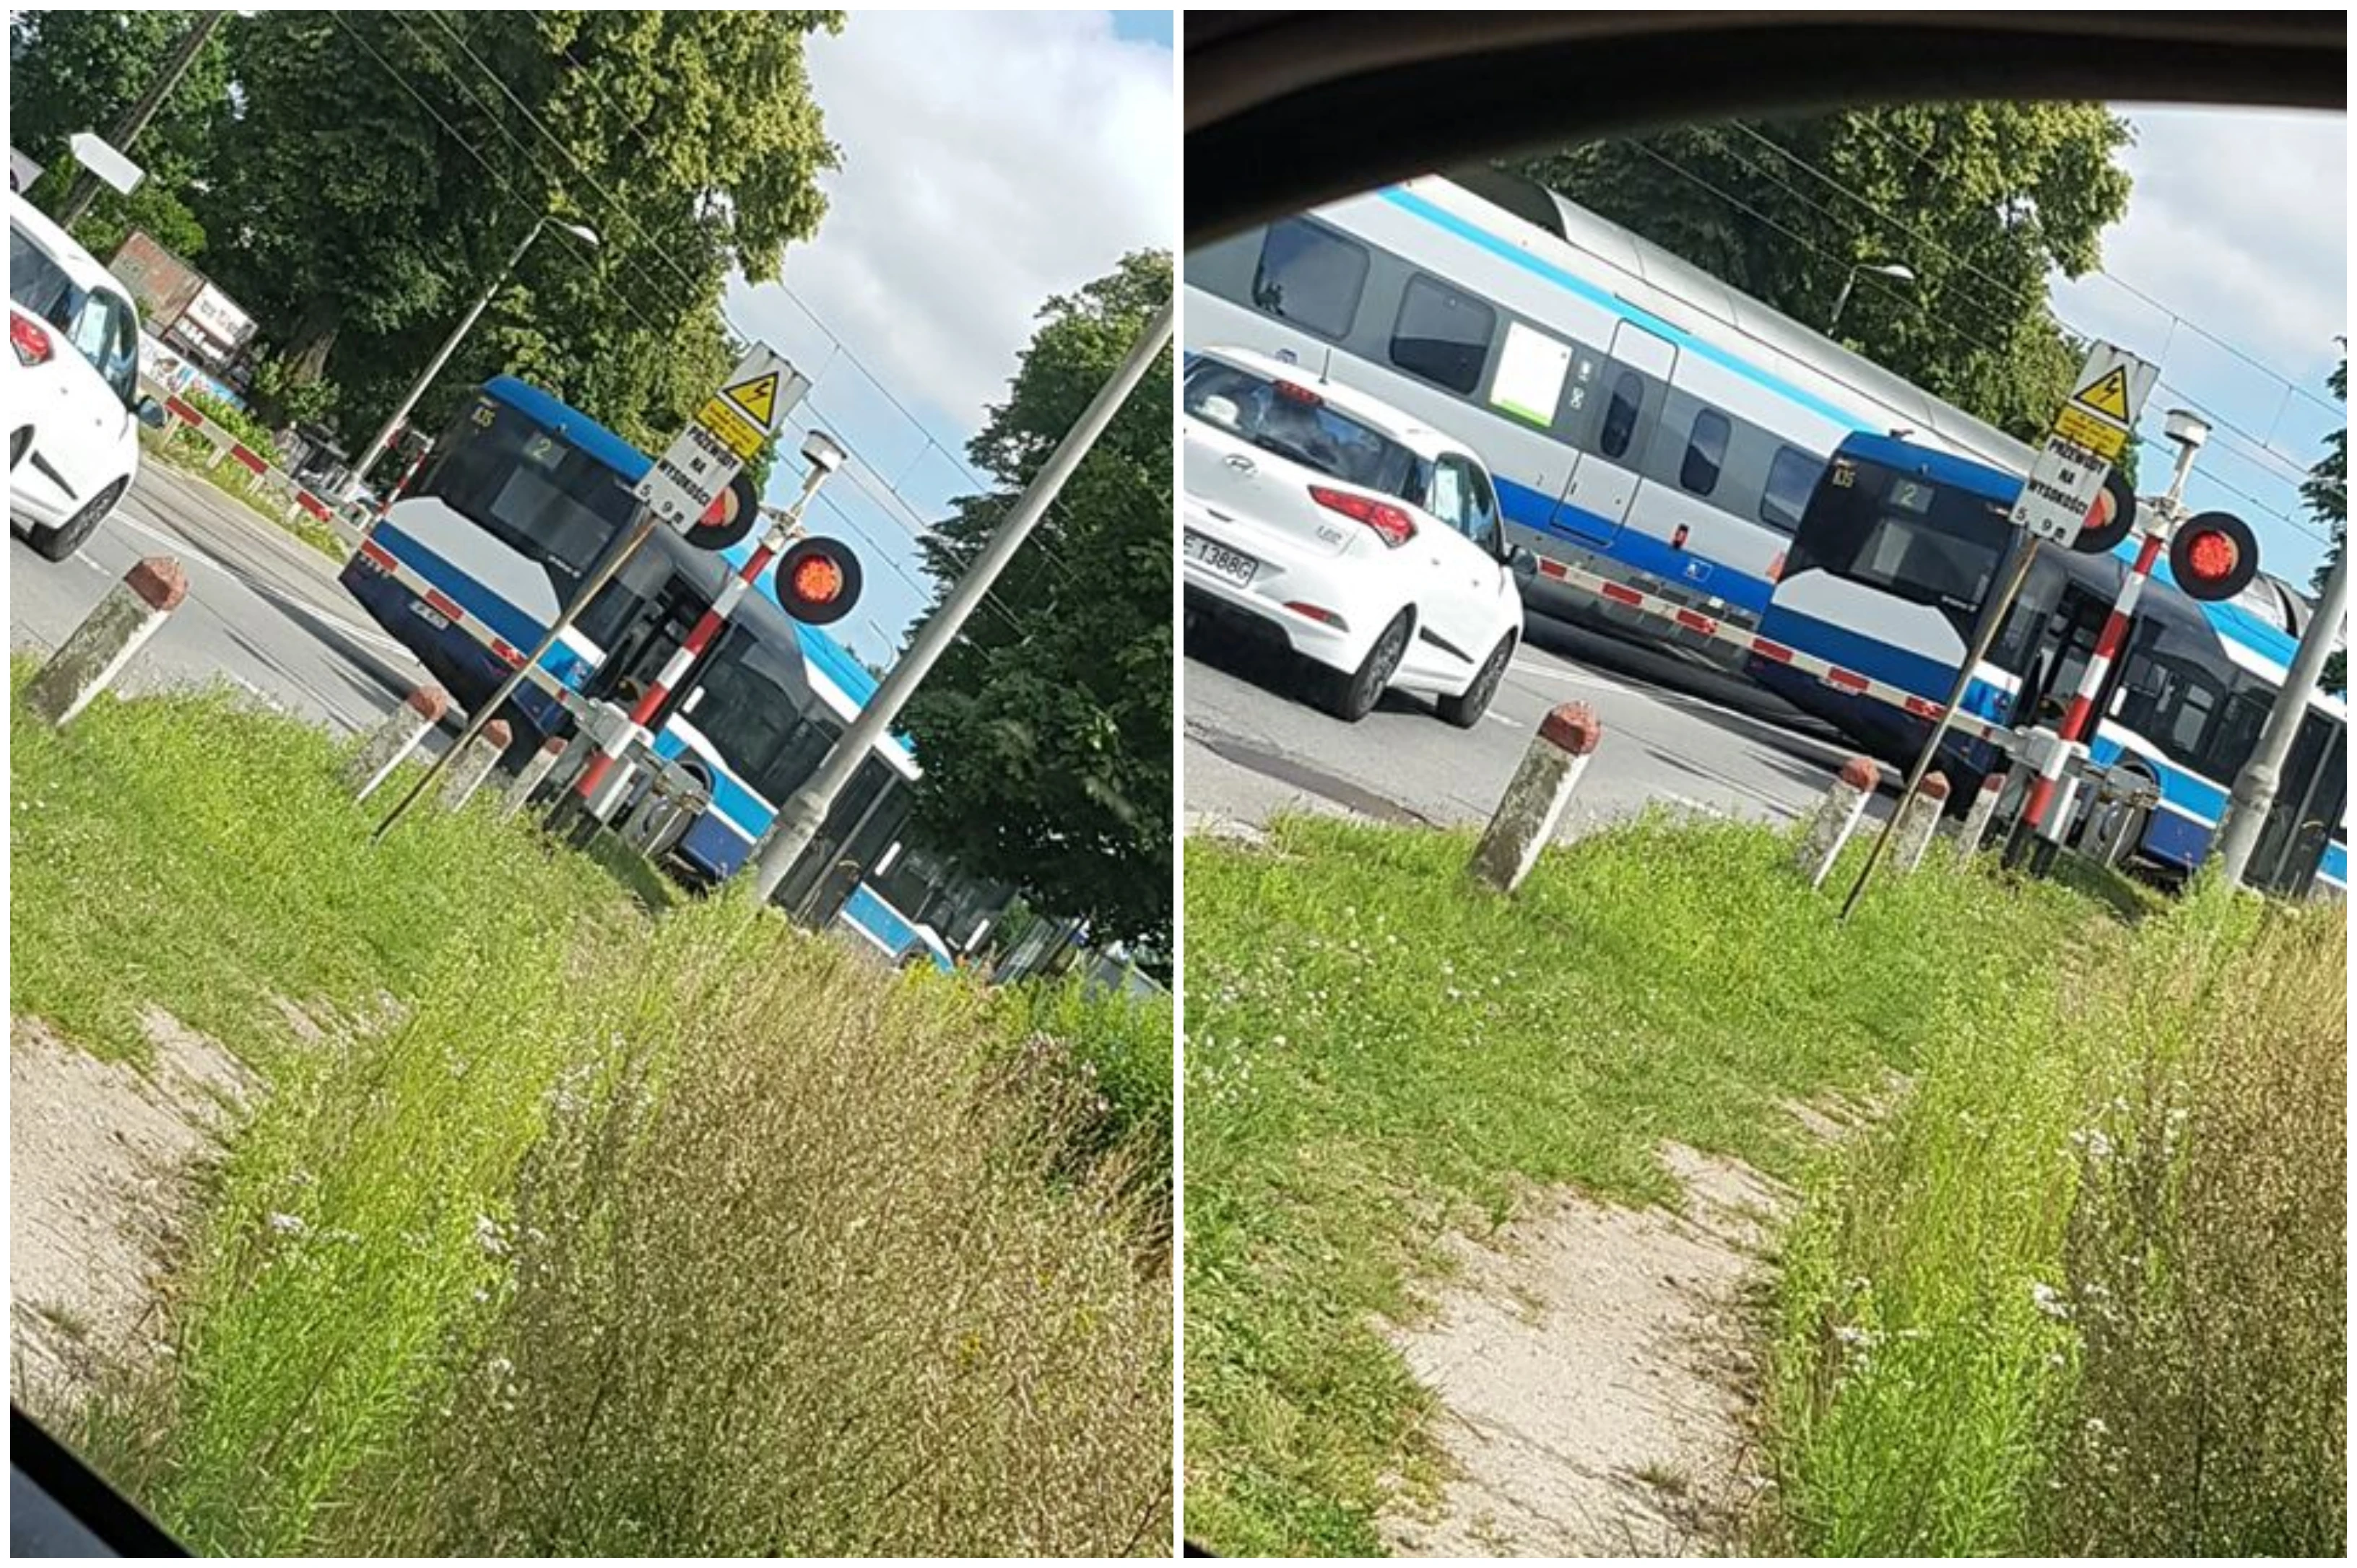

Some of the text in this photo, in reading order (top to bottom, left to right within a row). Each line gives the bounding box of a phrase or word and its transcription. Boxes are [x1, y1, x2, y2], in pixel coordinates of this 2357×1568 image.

[533, 437, 552, 461] 2
[689, 456, 708, 476] NA
[1901, 483, 1918, 506] 2
[1199, 543, 1253, 580] 1388G
